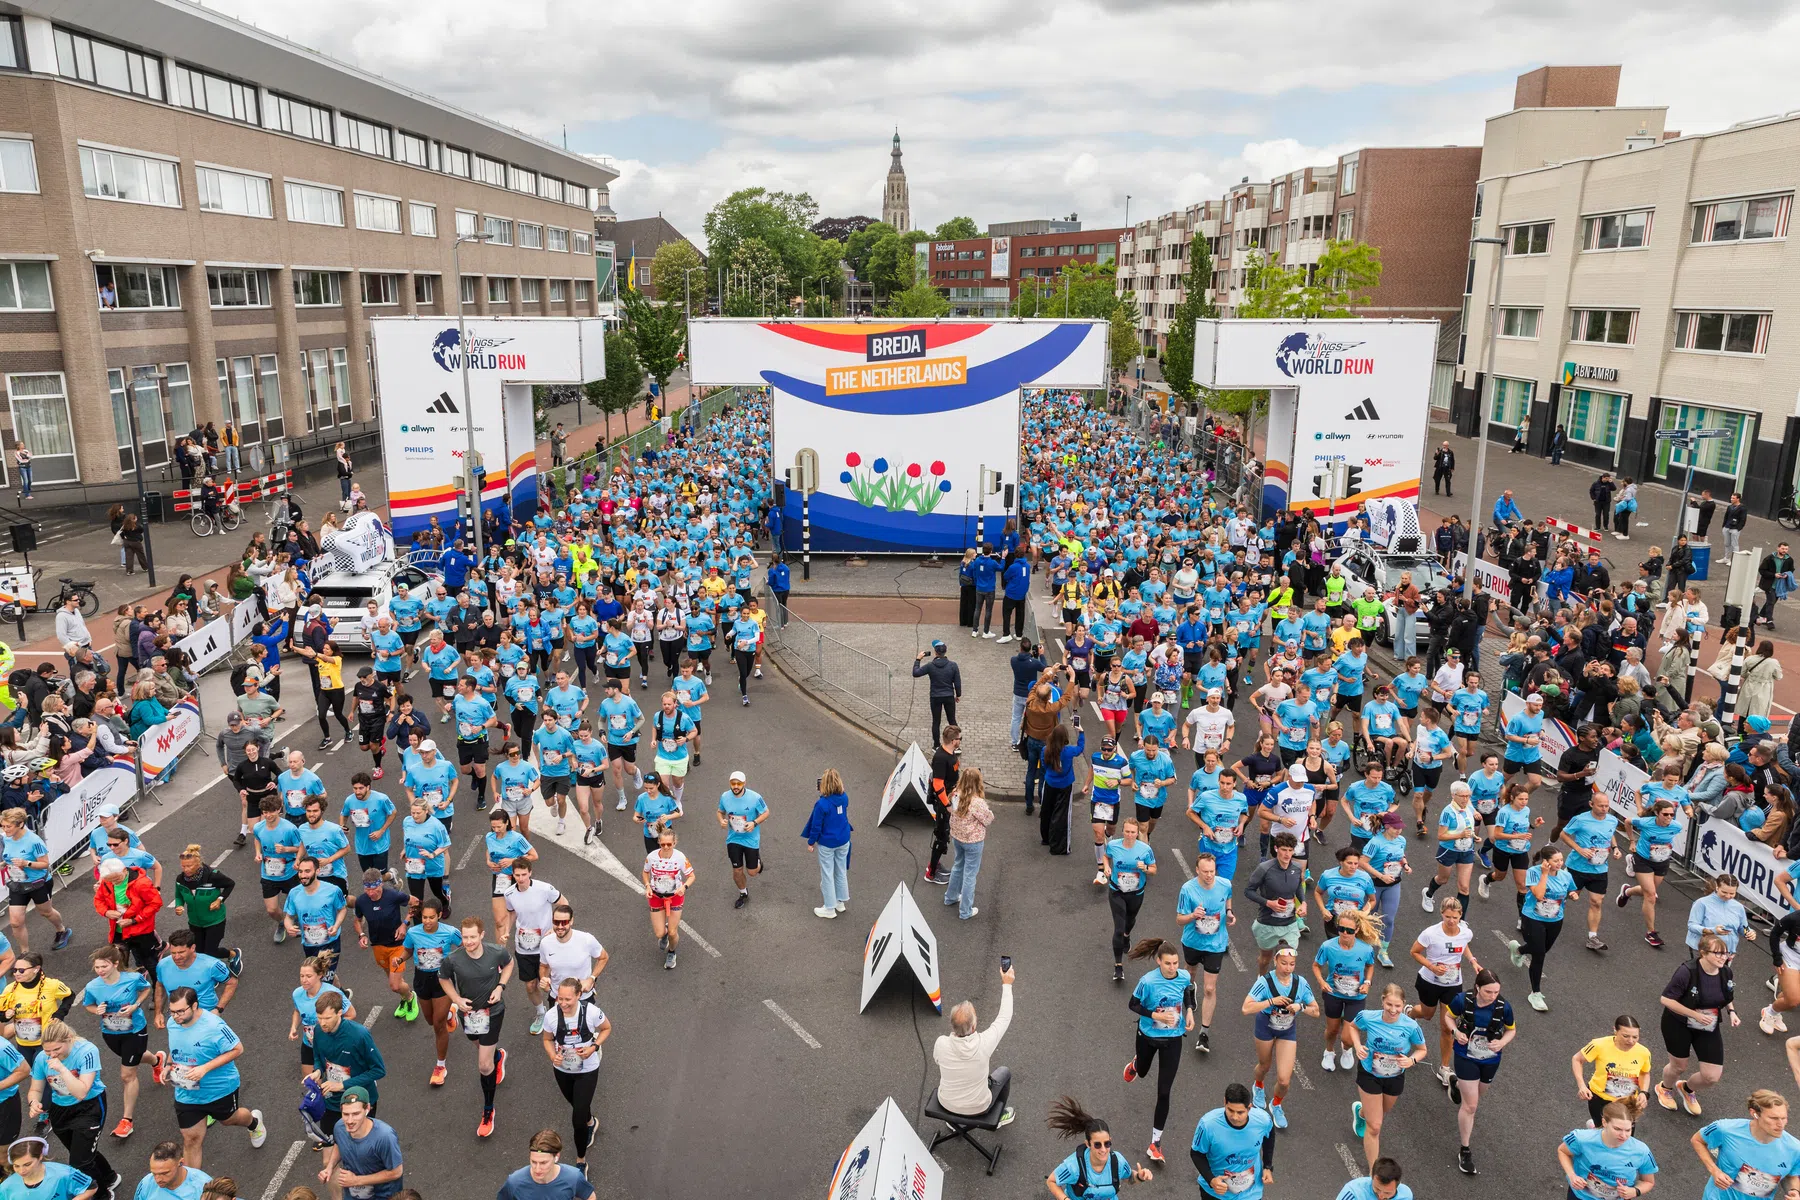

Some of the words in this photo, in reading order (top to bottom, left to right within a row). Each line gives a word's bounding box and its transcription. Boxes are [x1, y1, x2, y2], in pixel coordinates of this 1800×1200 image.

[872, 334, 921, 357] BREDA
[1307, 342, 1343, 351] WINGS
[498, 354, 526, 370] RUN
[1292, 358, 1343, 374] WORLD
[1344, 358, 1374, 374] RUN
[831, 371, 858, 390] THE
[861, 362, 962, 388] NETHERLANDS
[411, 425, 435, 433] allwyn
[1325, 432, 1351, 441] allwyn
[1541, 741, 1557, 756] BREDA
[74, 793, 102, 821] WINGS
[1612, 793, 1630, 810] LIFE
[911, 1162, 927, 1199] RUN
